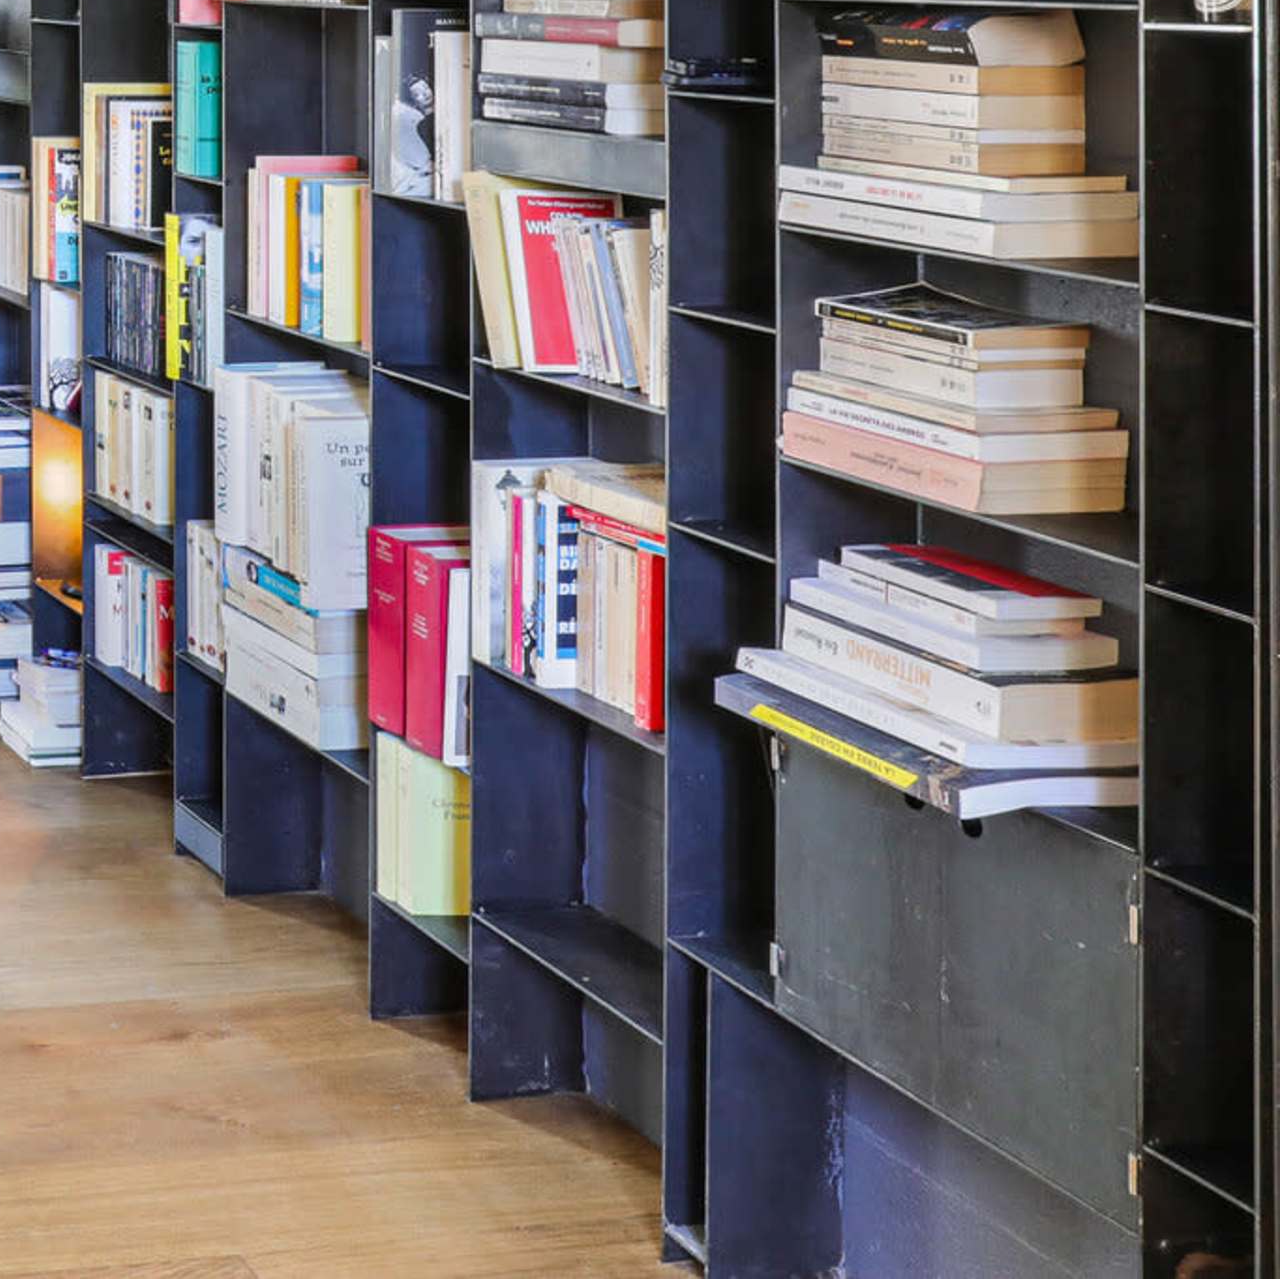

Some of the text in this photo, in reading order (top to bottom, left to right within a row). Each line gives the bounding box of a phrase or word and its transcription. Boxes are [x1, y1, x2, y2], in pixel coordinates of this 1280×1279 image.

[326, 442, 349, 454] Un
[340, 456, 366, 467] sur
[217, 414, 228, 514] MOZART
[846, 639, 932, 686] MITTERRAND
